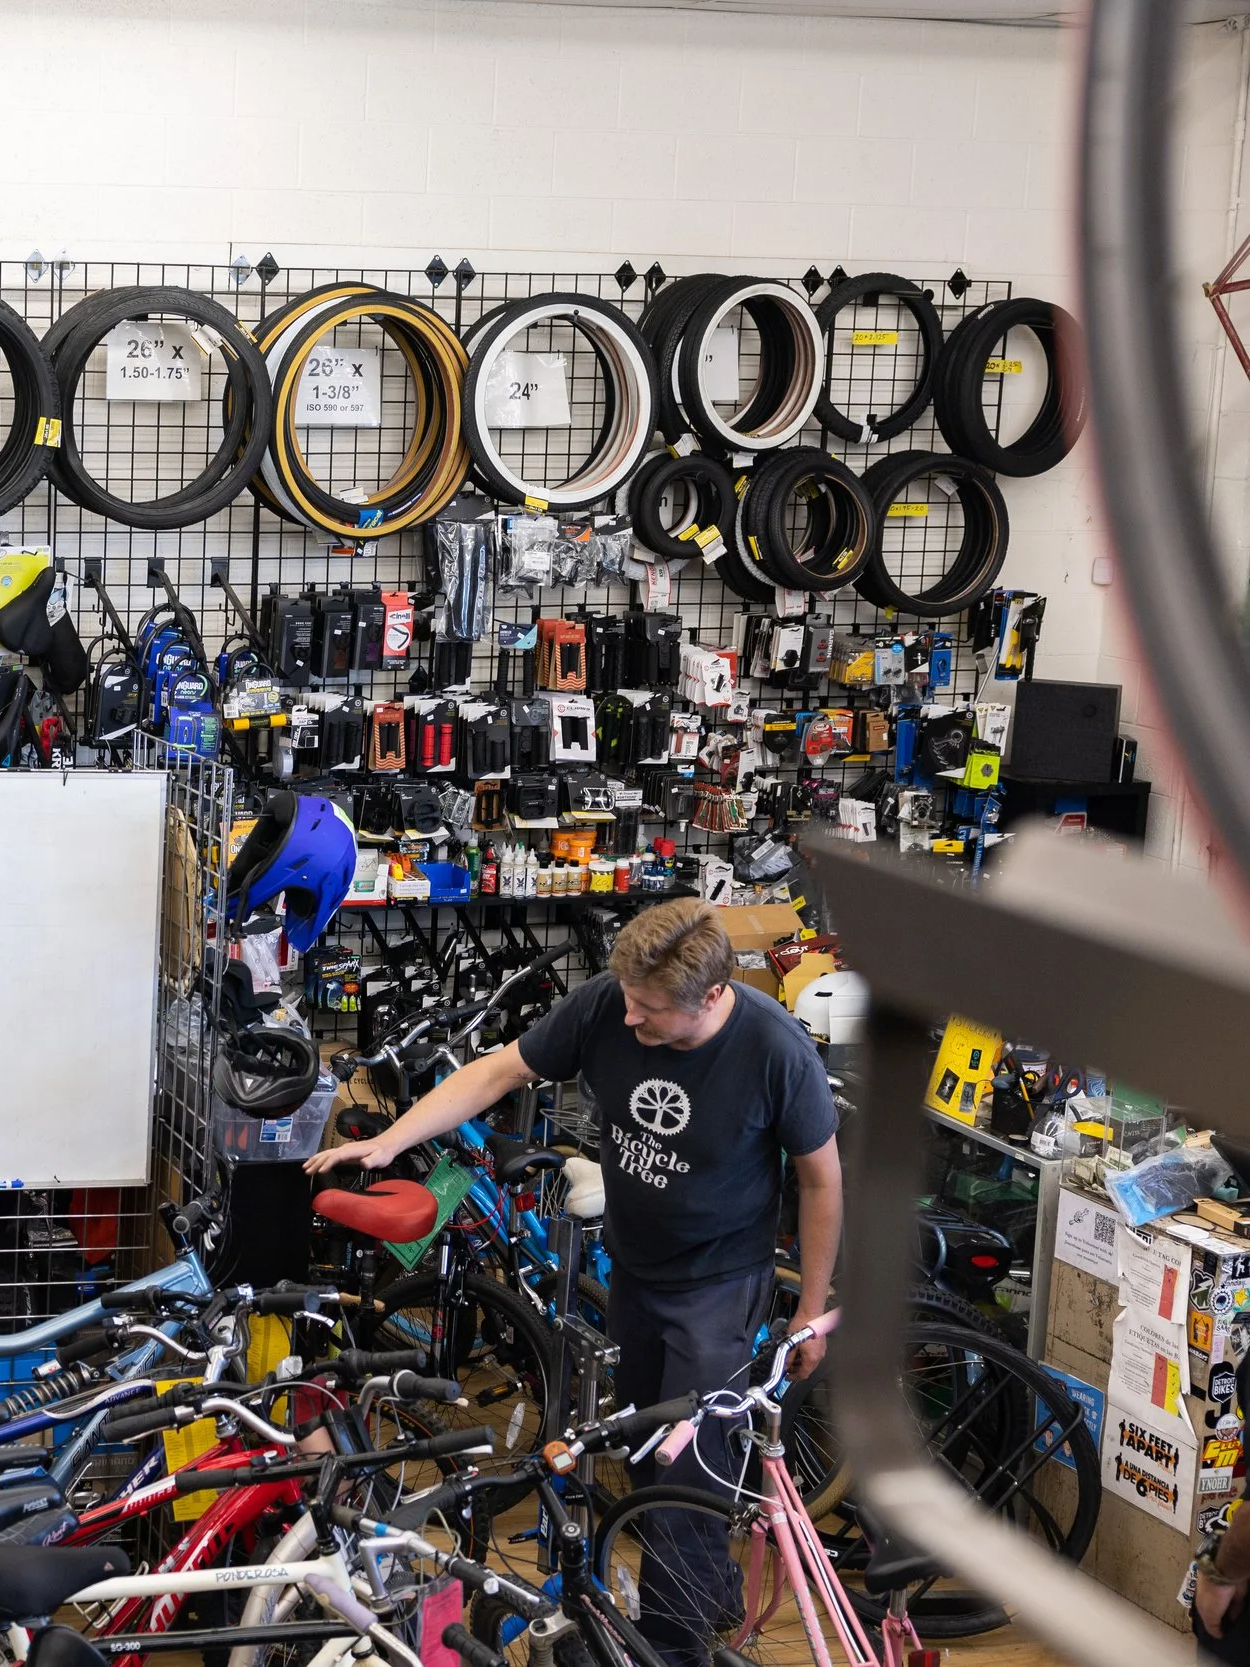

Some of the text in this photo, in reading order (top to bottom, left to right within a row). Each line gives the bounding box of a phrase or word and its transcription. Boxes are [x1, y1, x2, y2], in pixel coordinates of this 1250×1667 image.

[171, 345, 184, 360] x
[352, 363, 364, 377] x
[306, 404, 320, 412] ISO
[323, 404, 338, 412] 590
[350, 404, 364, 412] 597
[826, 629, 835, 659] GARMIN
[610, 1123, 691, 1174] Bicycle
[639, 1131, 663, 1151] The
[618, 1146, 668, 1189] Tree
[1214, 1376, 1236, 1387] DETROIT
[1214, 1384, 1236, 1395] BIKES
[1128, 1422, 1173, 1454] SIX FEET
[1126, 1434, 1172, 1469] APART
[1130, 1462, 1141, 1475] UNA
[1142, 1470, 1170, 1490] DISTANCIA
[1201, 1477, 1230, 1491] YNOHR
[1123, 1468, 1170, 1504] DE 6 PIES
[215, 1568, 288, 1583] PONDEROSA
[110, 1641, 141, 1652] SG-300
